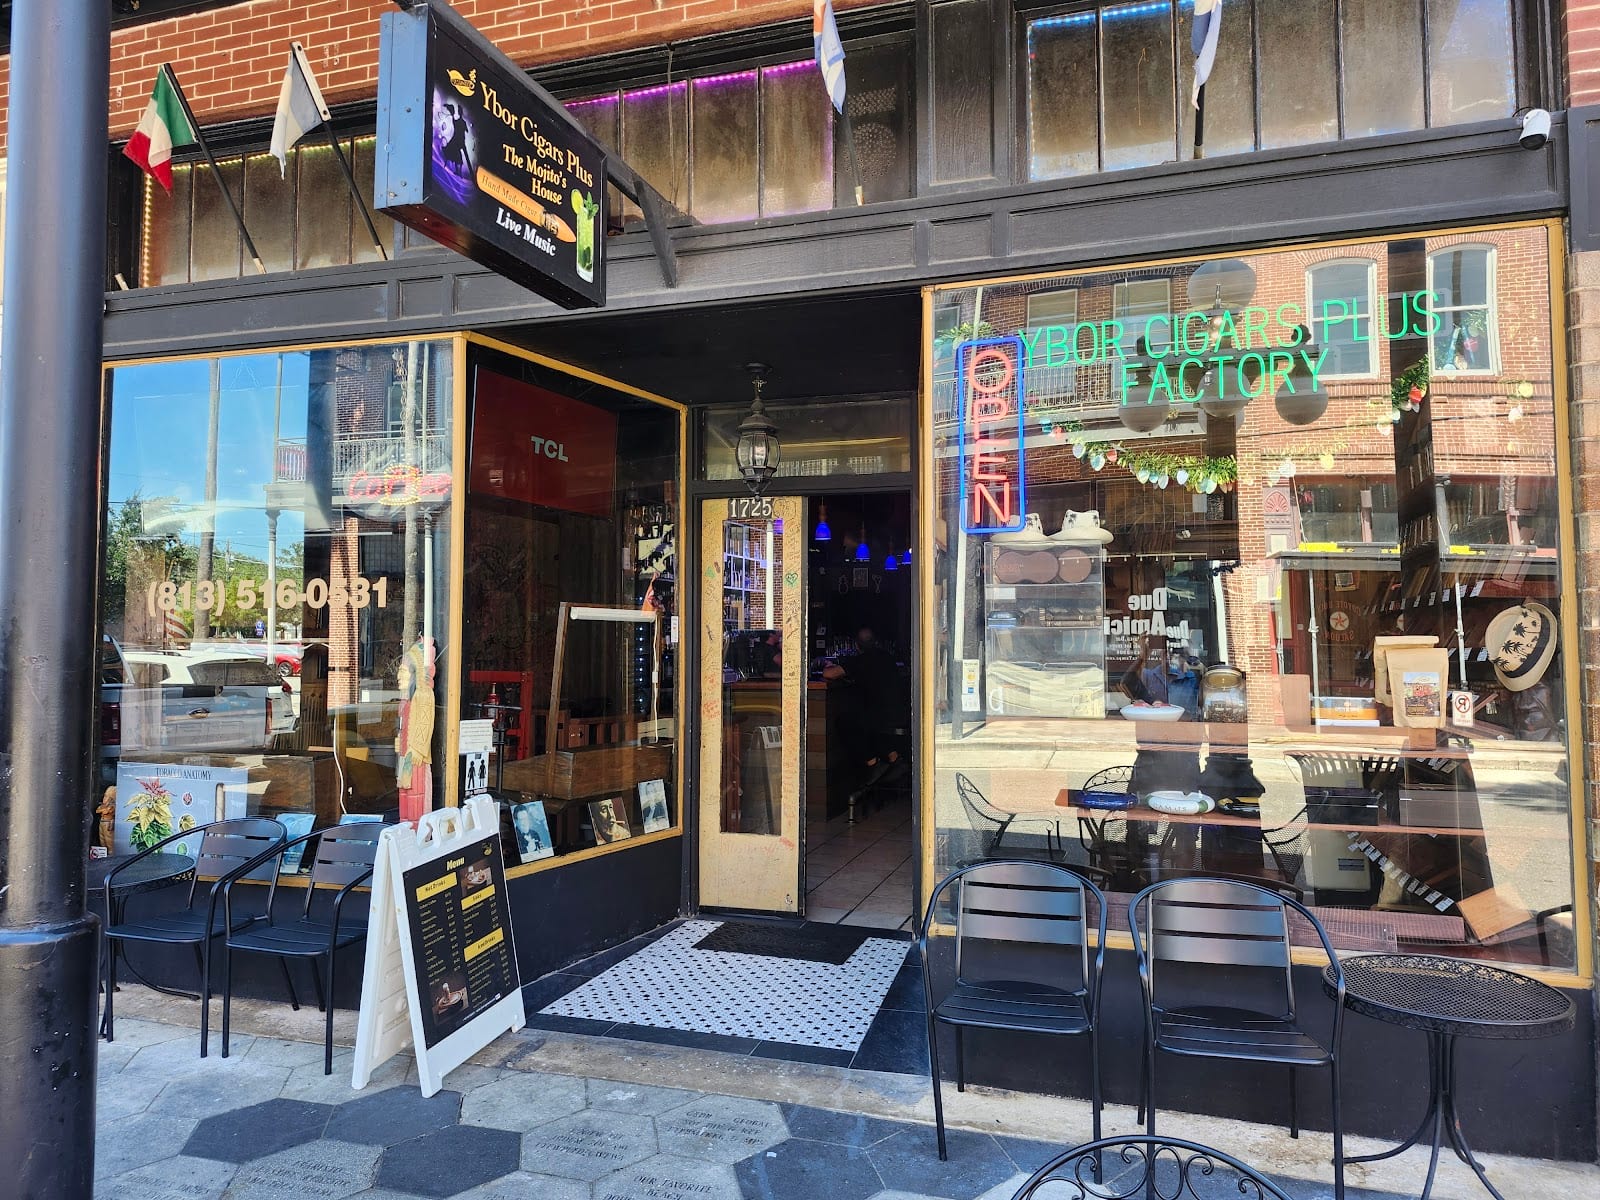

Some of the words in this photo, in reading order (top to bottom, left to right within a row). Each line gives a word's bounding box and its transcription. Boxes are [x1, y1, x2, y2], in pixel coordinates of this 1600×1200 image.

[480, 81, 518, 130] Ybor
[520, 116, 564, 165] Cigars
[567, 149, 593, 188] Plus
[502, 143, 524, 169] The
[526, 153, 567, 188] Mojito's
[482, 175, 501, 195] Hand
[502, 187, 519, 206] Made
[520, 200, 538, 217] Cigar
[531, 178, 563, 205] House
[496, 207, 522, 235] Live
[523, 226, 556, 257] Music
[1018, 319, 1125, 369] YBOR
[1144, 301, 1304, 360] CIGARS
[1322, 289, 1442, 344] PLUS
[1121, 348, 1329, 406] FACTORY
[530, 436, 569, 463] TCL
[967, 348, 1014, 525] OPEN
[730, 498, 773, 518] 1725
[148, 580, 226, 617] (813)
[236, 576, 388, 611] 516-0531
[183, 769, 213, 781] ANATOMY
[446, 857, 466, 872] Menu
[661, 1179, 714, 1193] FAVORITE
